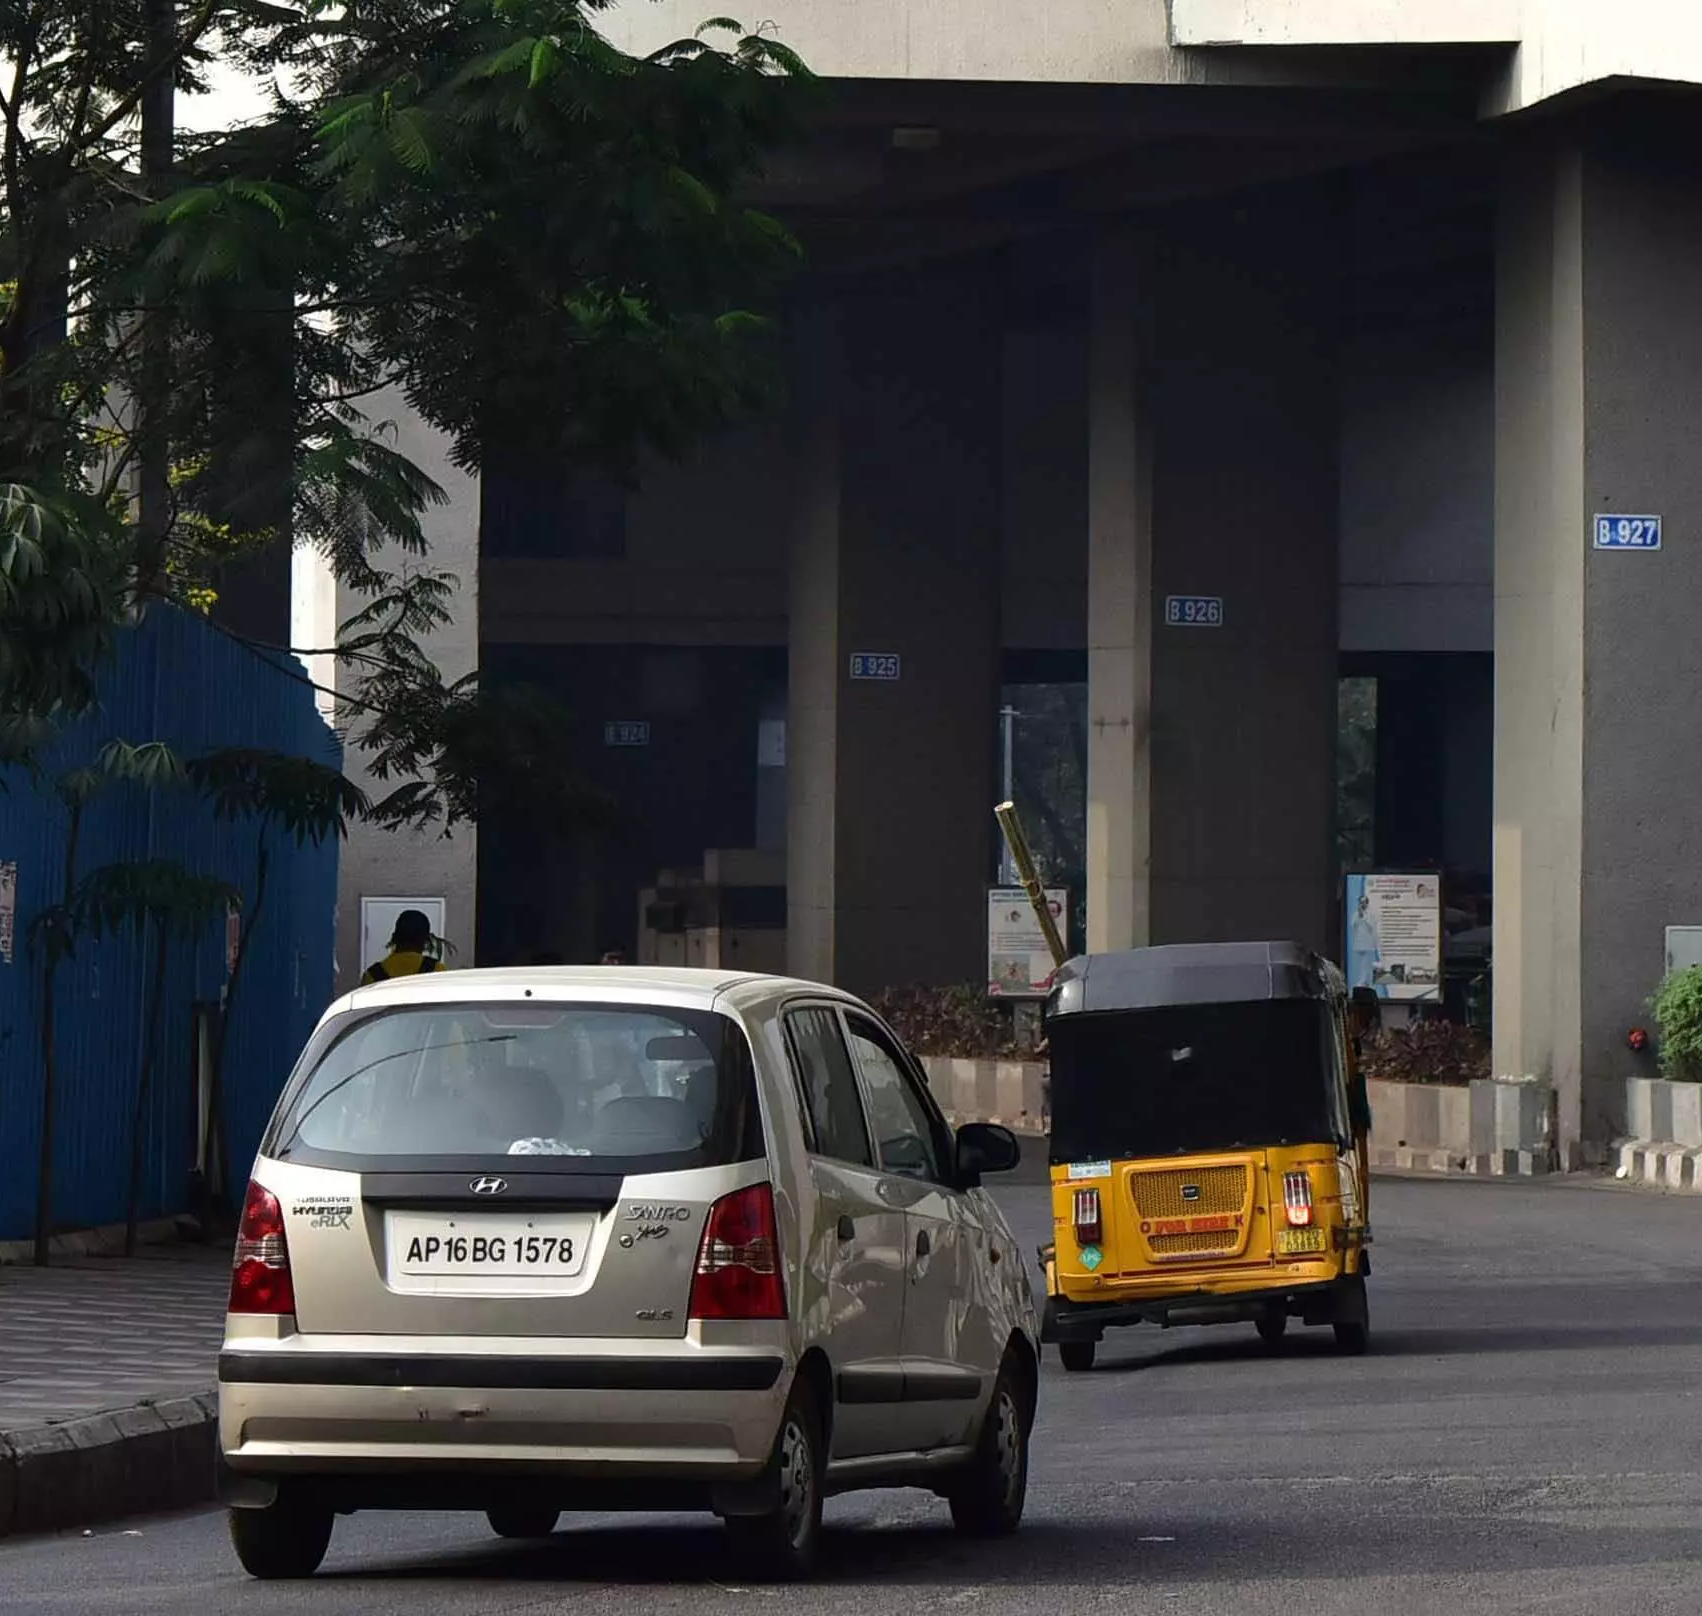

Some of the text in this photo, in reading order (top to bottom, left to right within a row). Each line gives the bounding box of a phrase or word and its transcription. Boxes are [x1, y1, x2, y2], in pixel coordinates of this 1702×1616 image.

[1599, 519, 1657, 545] B 927
[1170, 600, 1219, 622] B 926
[868, 657, 896, 676] 925
[406, 1237, 573, 1263] AP 16 BG 1578
